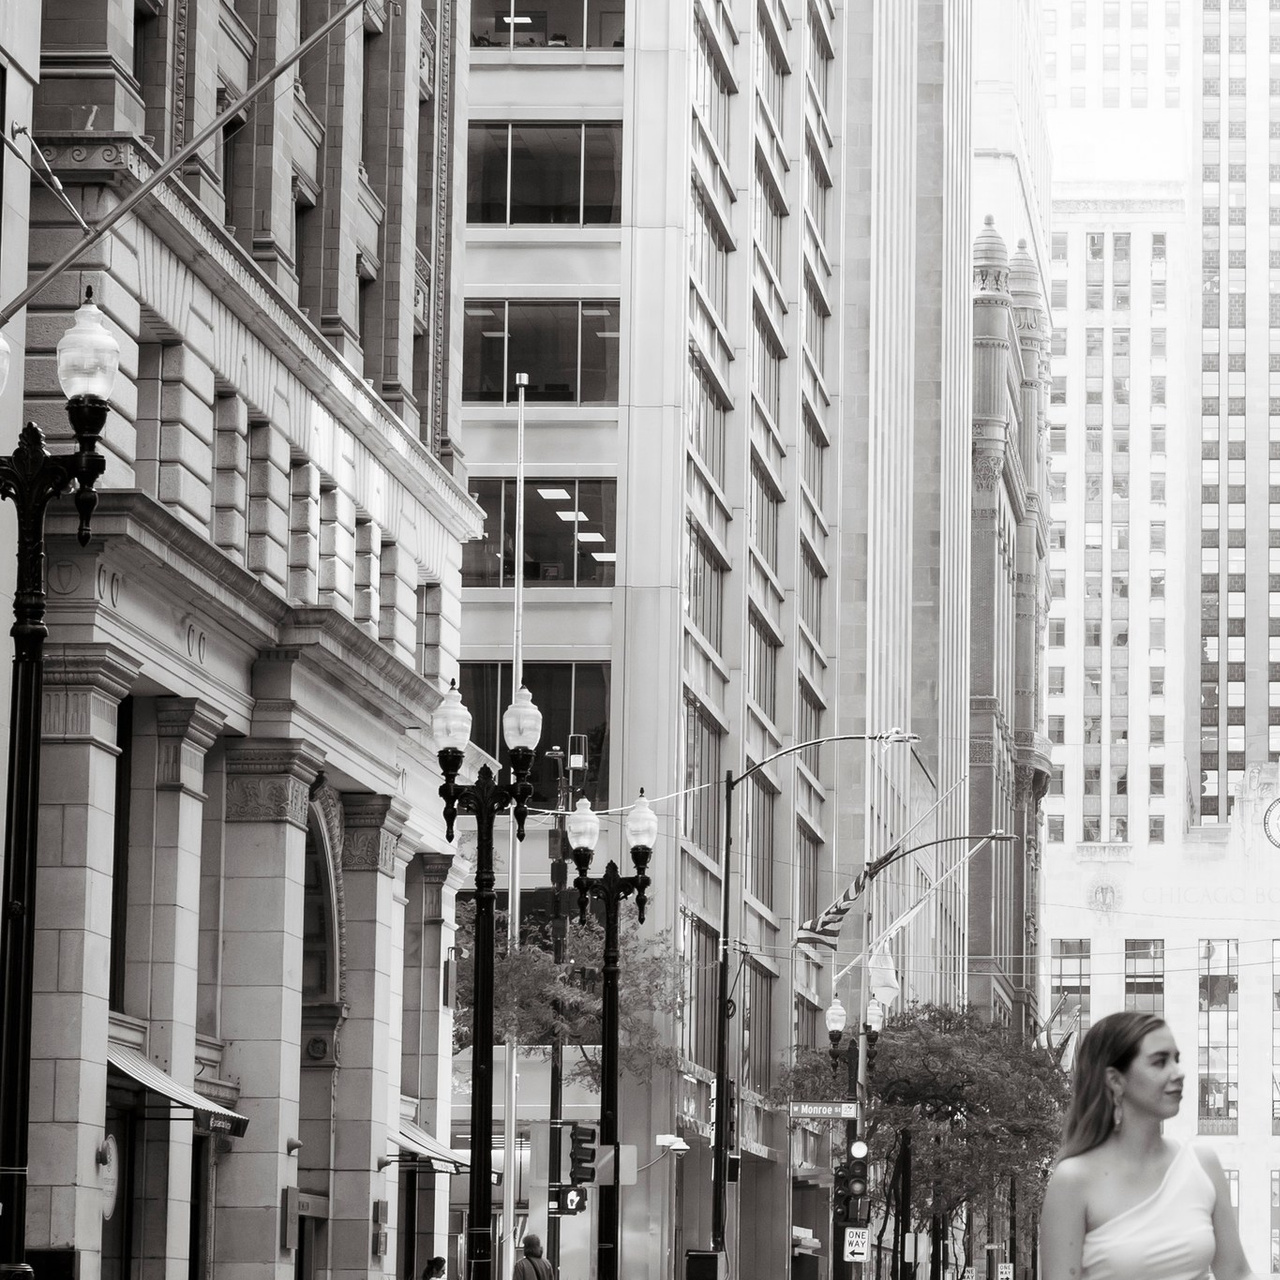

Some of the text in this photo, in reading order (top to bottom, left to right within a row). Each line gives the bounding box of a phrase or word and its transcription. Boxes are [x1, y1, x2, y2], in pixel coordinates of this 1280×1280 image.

[1142, 886, 1245, 905] CHICAGO
[801, 1104, 832, 1114] Monroe
[849, 1231, 866, 1239] ONE
